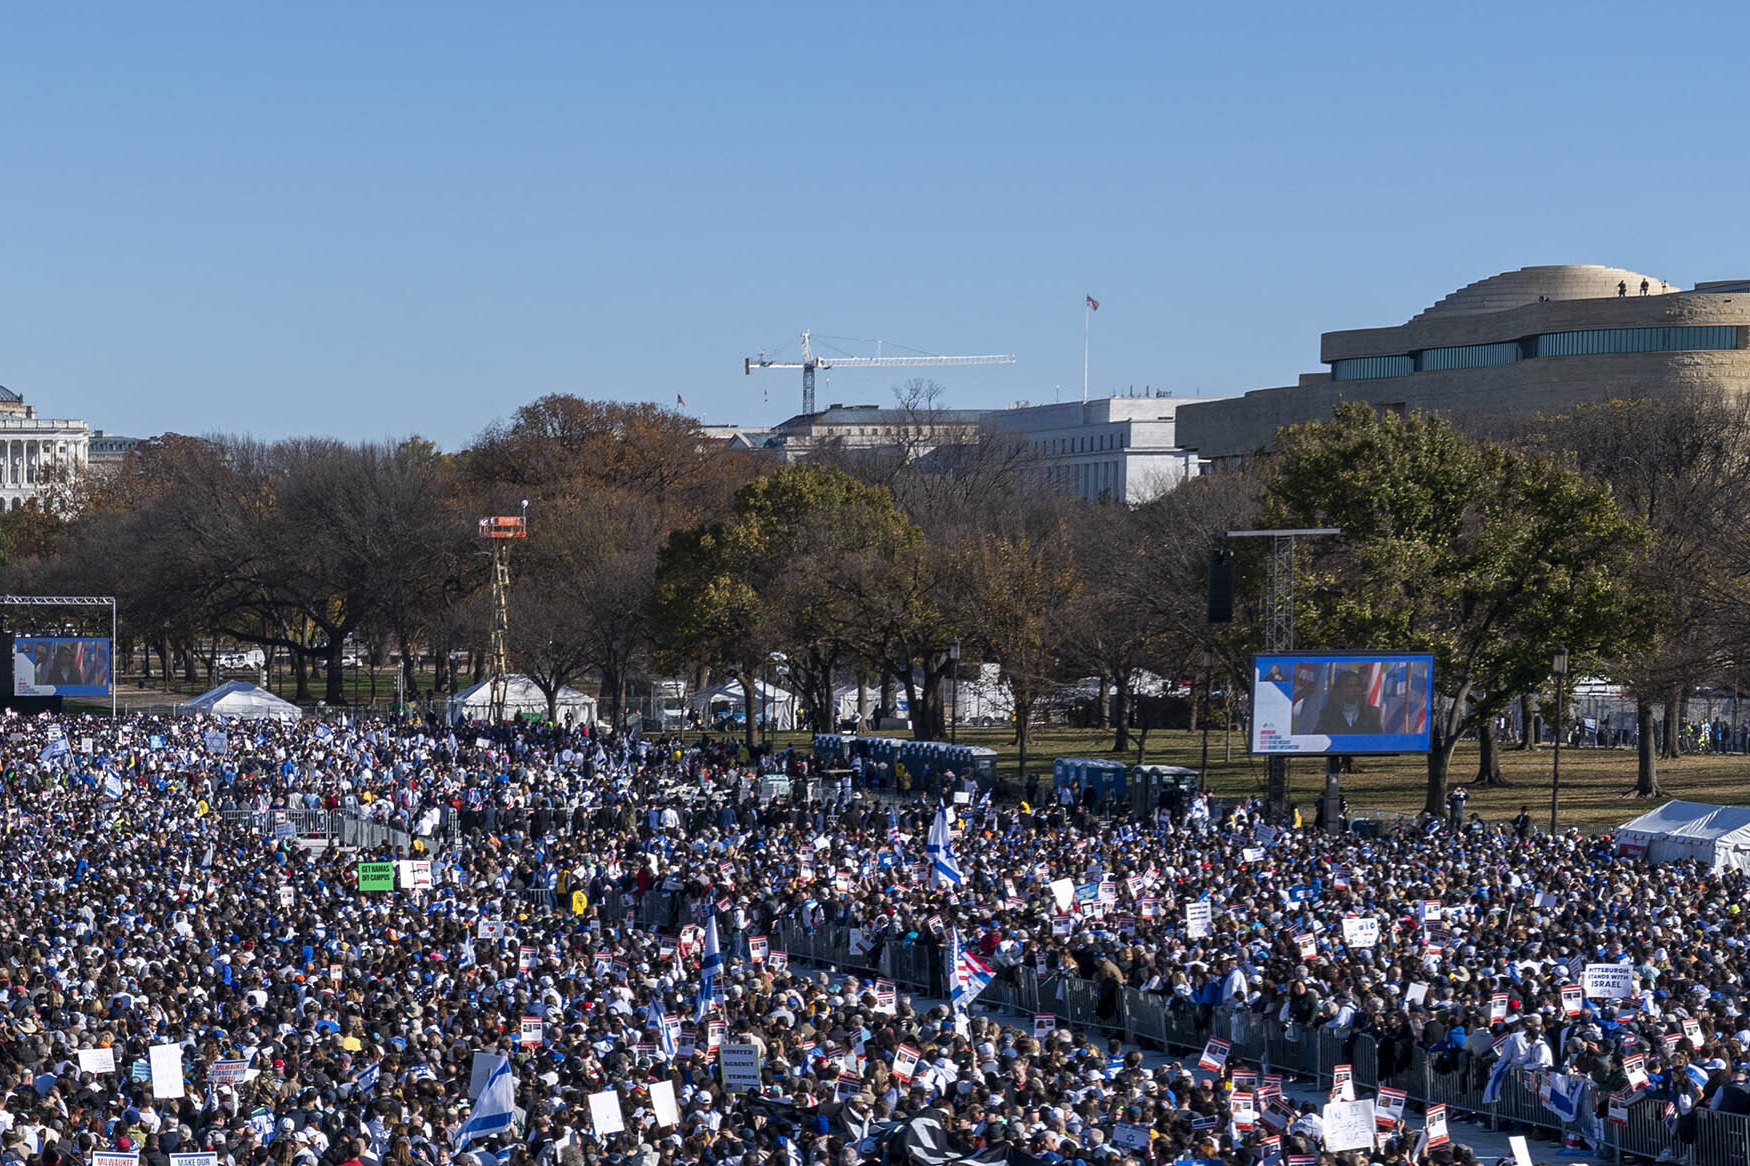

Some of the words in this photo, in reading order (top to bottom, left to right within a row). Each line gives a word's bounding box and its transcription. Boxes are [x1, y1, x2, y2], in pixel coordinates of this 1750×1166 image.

[1591, 980, 1621, 988] ISRAEL
[215, 1063, 246, 1071] MILWAUKEE
[177, 1158, 196, 1166] MAKE
[197, 1158, 210, 1166] OUR
